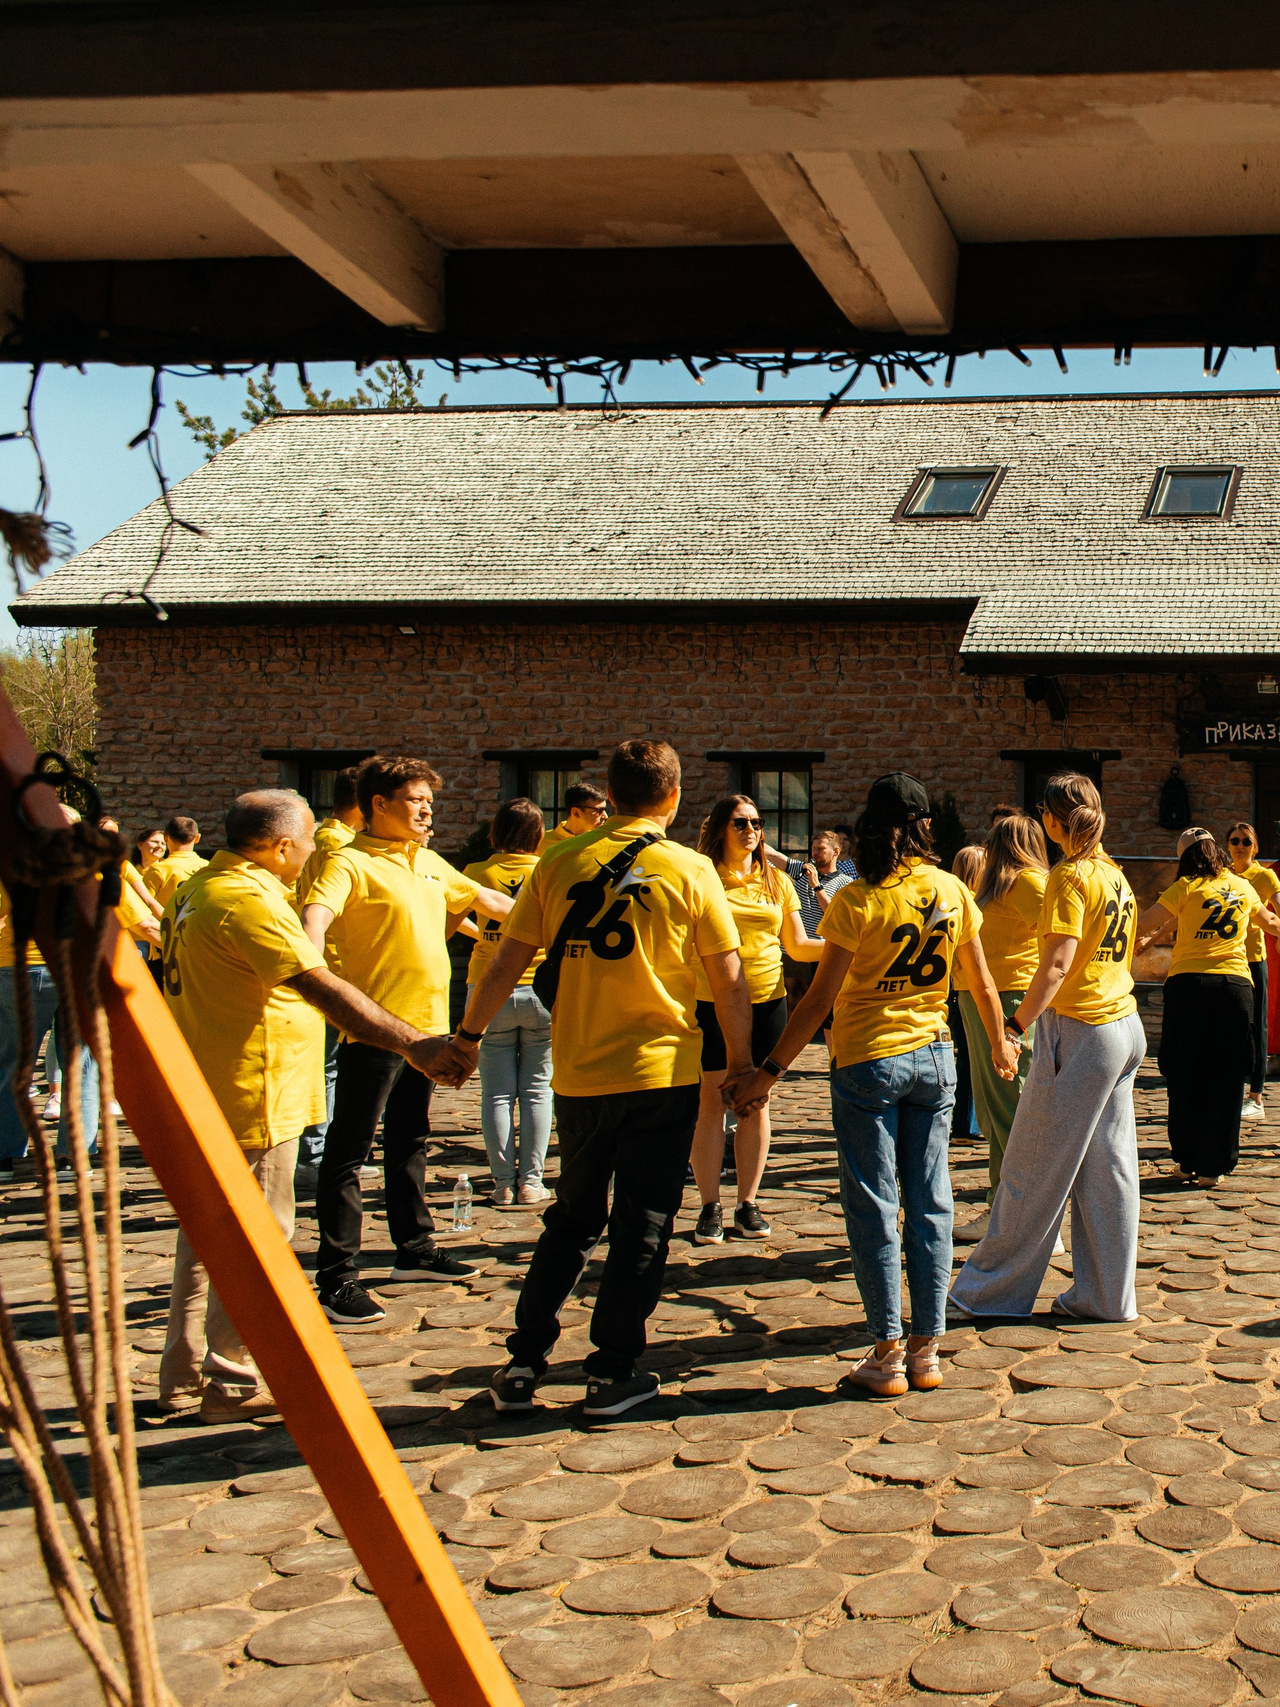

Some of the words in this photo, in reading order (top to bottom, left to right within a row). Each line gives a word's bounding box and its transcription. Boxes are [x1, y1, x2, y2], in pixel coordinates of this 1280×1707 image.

[1200, 899, 1238, 940] 26
[483, 932, 502, 941] ЛЕТ
[1100, 900, 1128, 962] 26
[1194, 931, 1215, 939] ЛЕТ
[884, 922, 947, 987] 26
[1091, 951, 1111, 962] ЛЕТ
[875, 980, 908, 993] ЛЕТ
